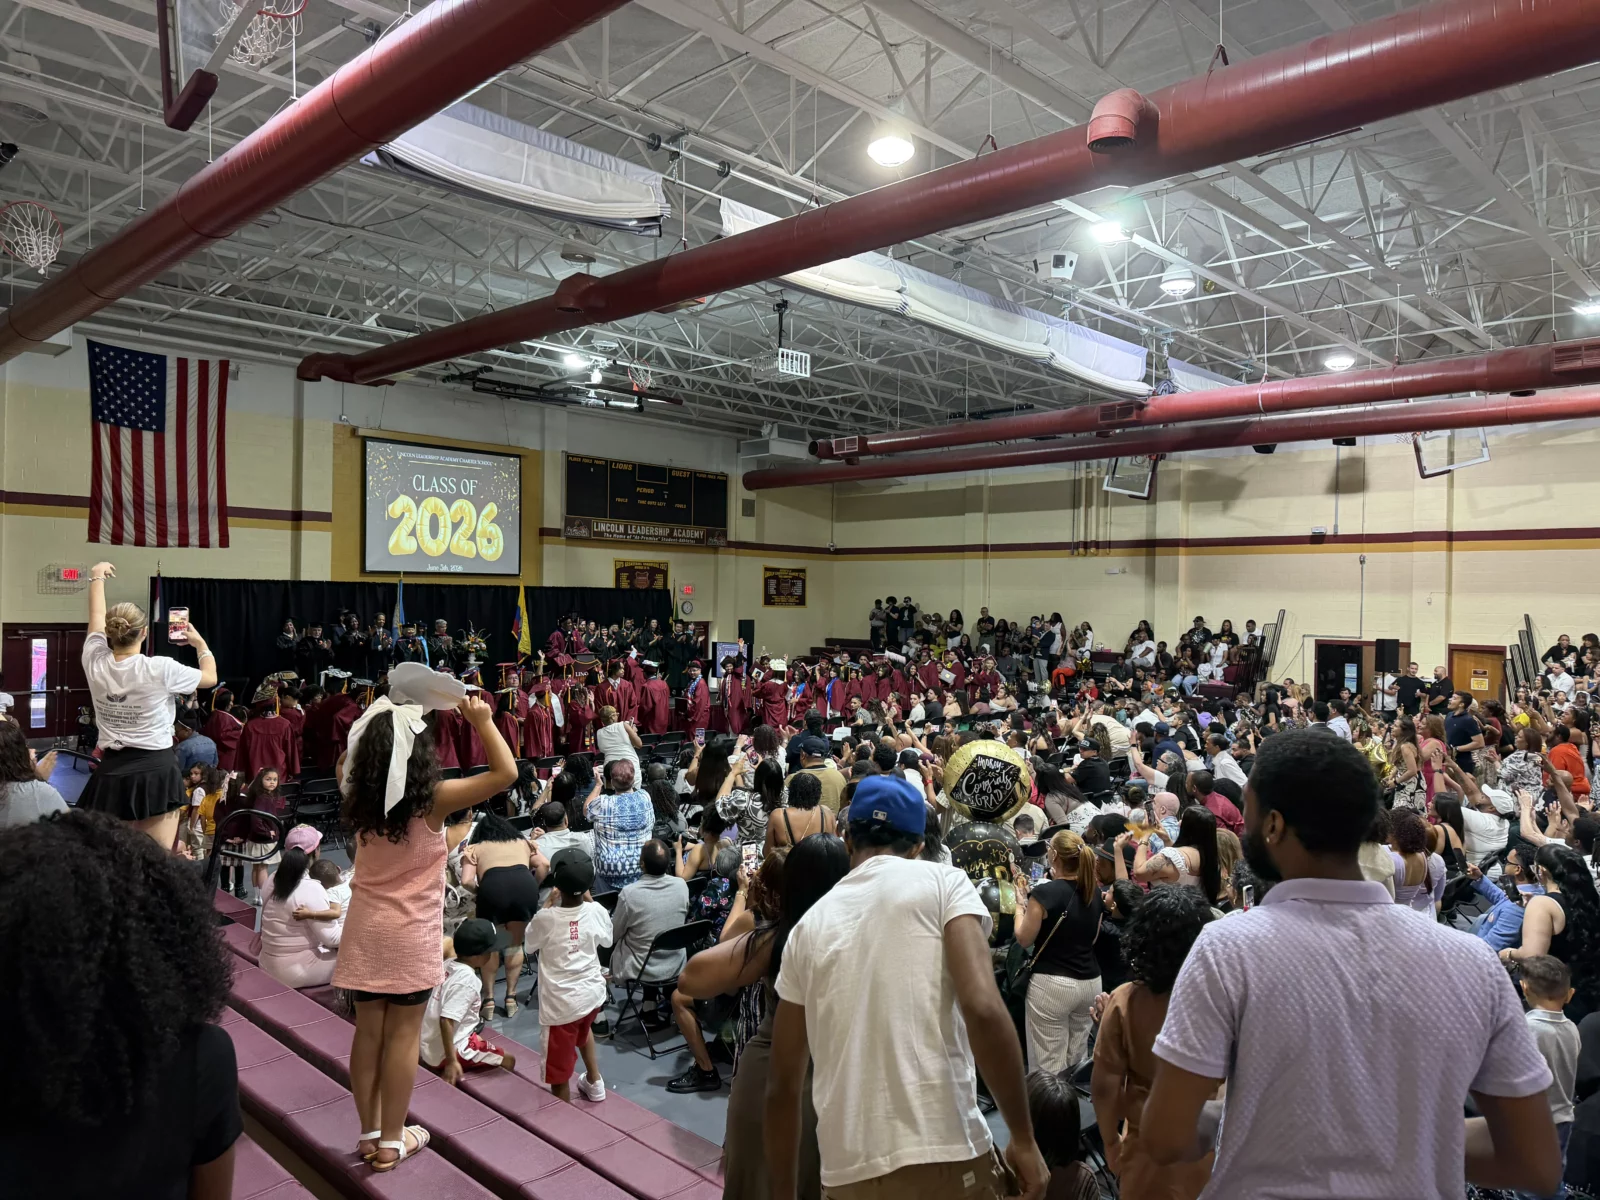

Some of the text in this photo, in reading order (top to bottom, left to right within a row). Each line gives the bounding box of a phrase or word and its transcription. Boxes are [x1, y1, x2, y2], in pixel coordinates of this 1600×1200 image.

[413, 474, 478, 495] CLASS OF
[388, 494, 504, 562] 2026
[594, 522, 624, 533] LINCOLN
[628, 525, 670, 536] LEADERSHIP
[673, 529, 704, 539] ACADEMY
[64, 569, 78, 579] EXIT
[962, 766, 1013, 796] Congrats
[975, 789, 1002, 809] GRAD
